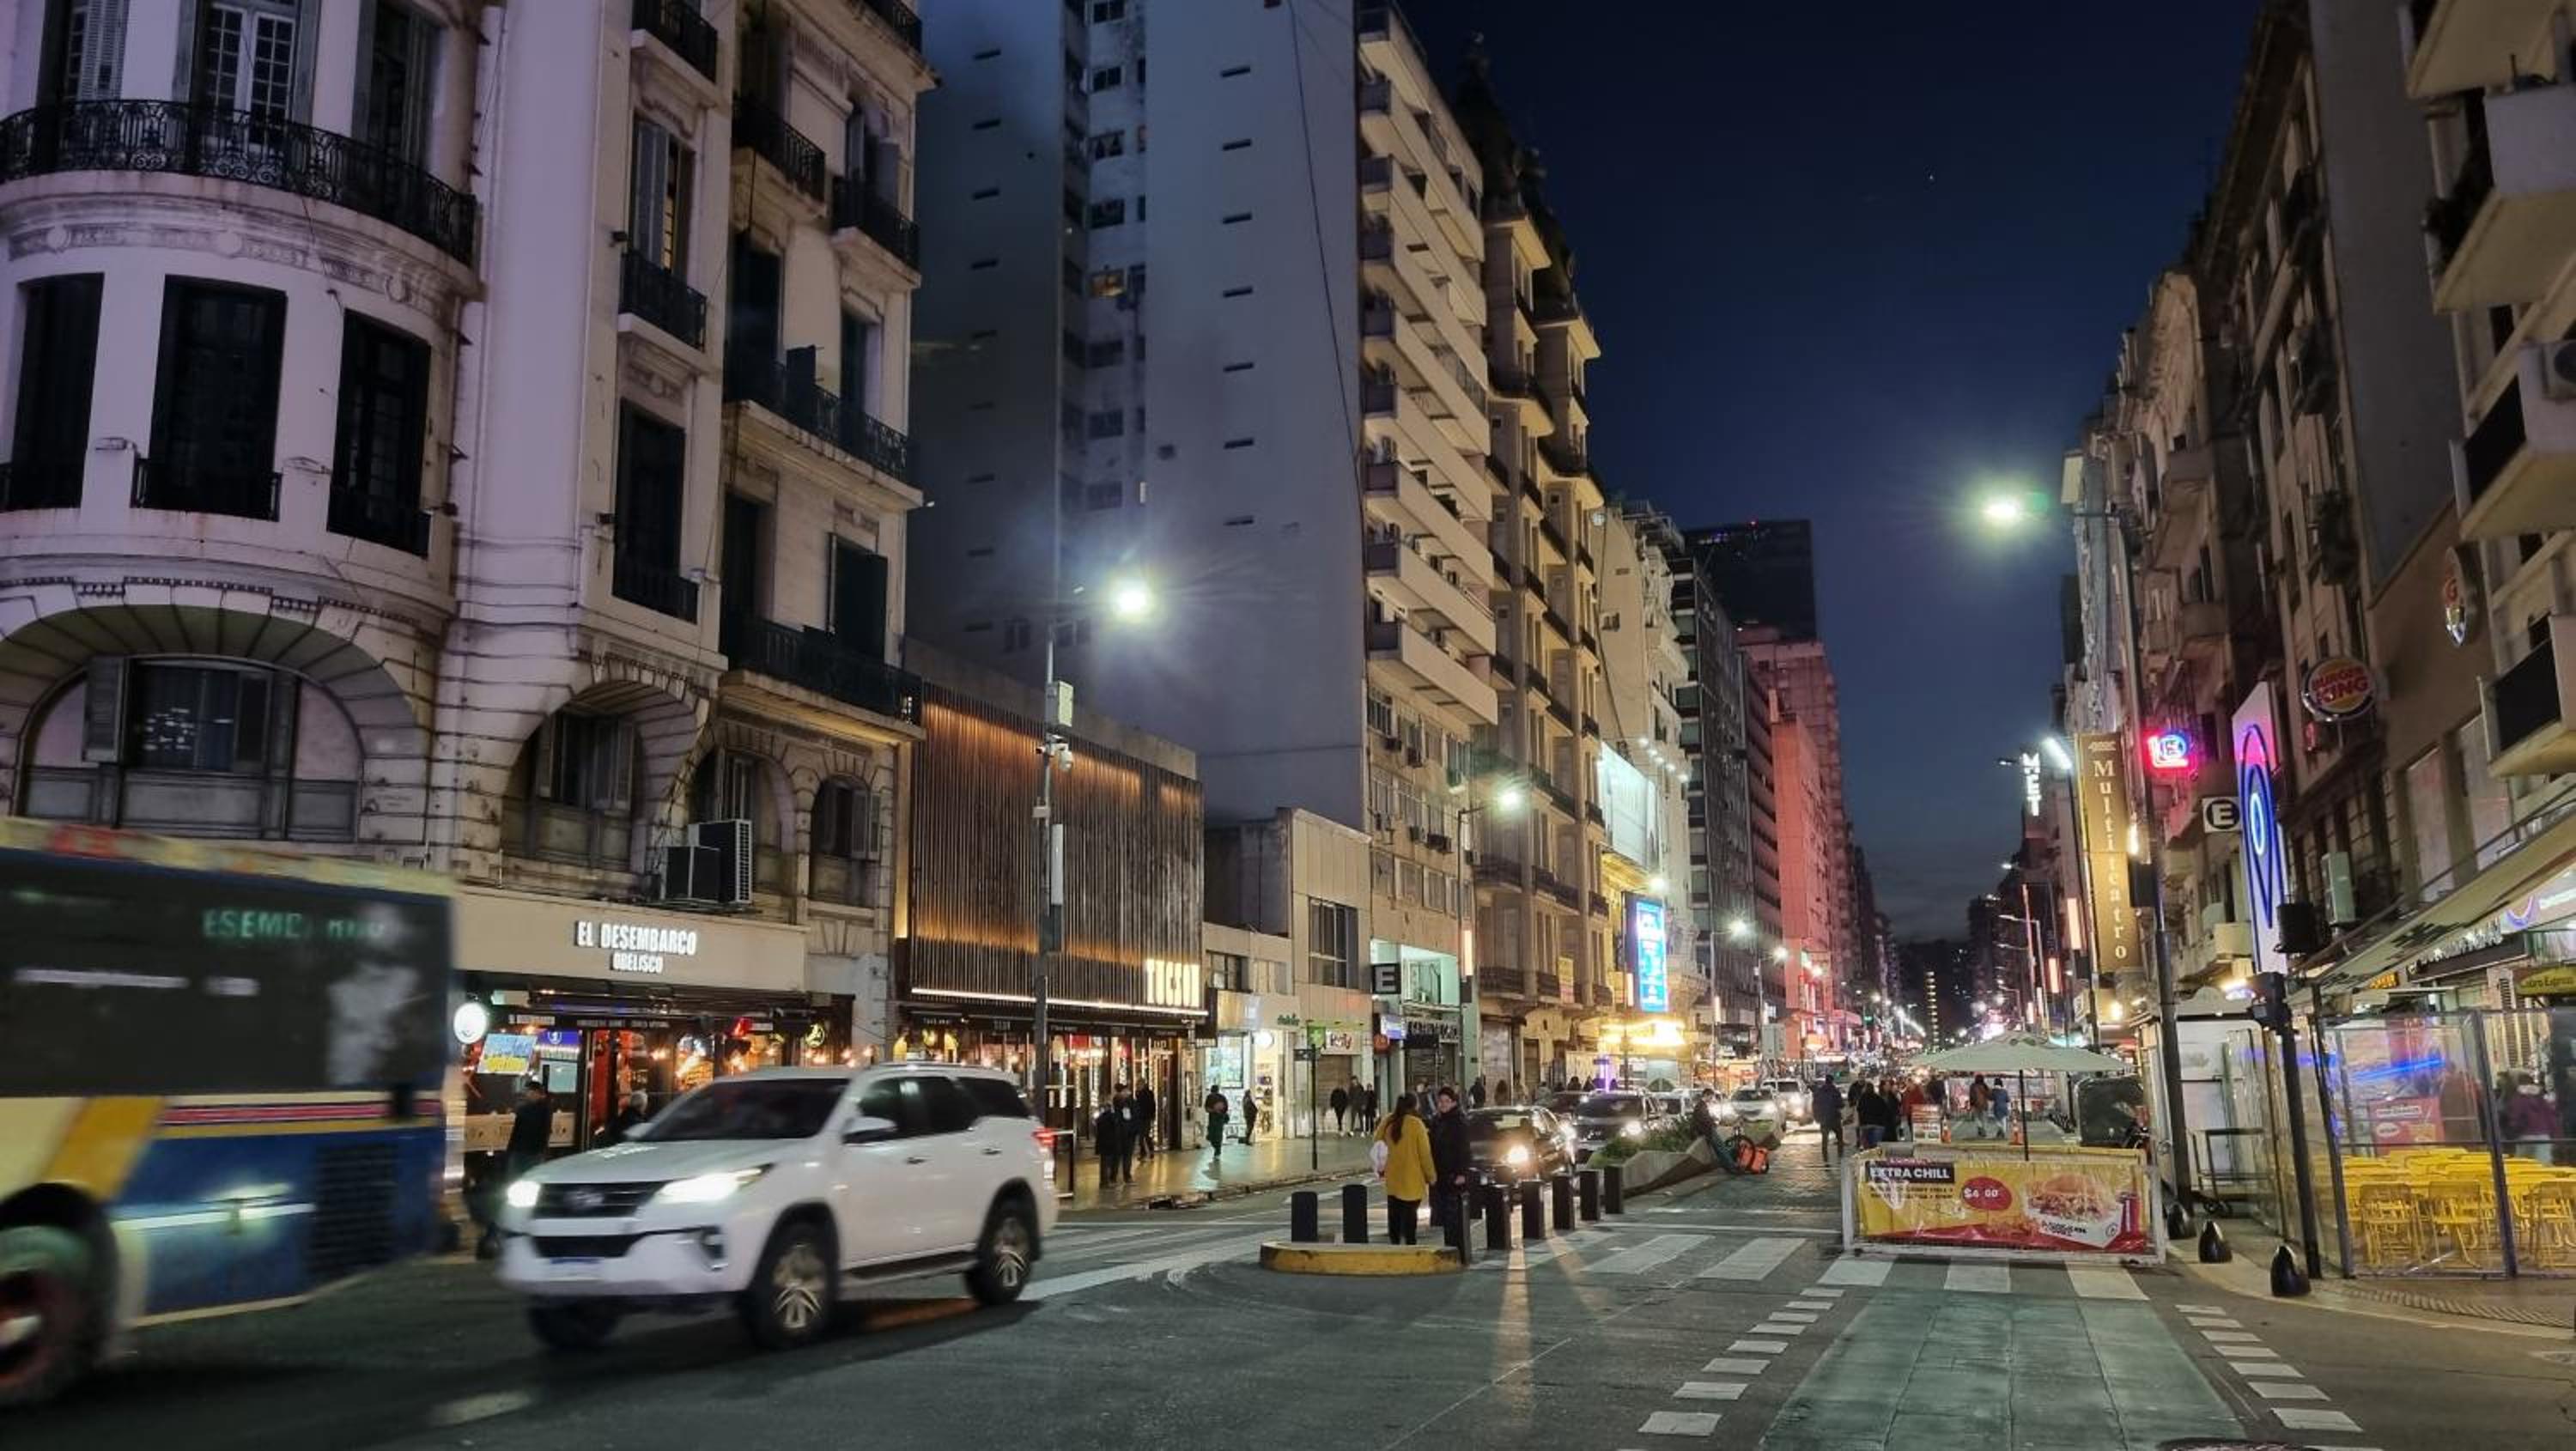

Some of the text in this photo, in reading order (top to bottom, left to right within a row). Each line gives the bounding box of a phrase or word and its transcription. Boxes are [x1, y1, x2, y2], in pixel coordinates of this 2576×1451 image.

[2316, 675, 2369, 707] KING
[2217, 804, 2233, 824] E
[577, 920, 697, 956] EL DESEMBARCO
[611, 951, 664, 974] OBELISCO
[1381, 967, 1396, 987] E
[1869, 1166, 1950, 1180] EXTRA CHILL
